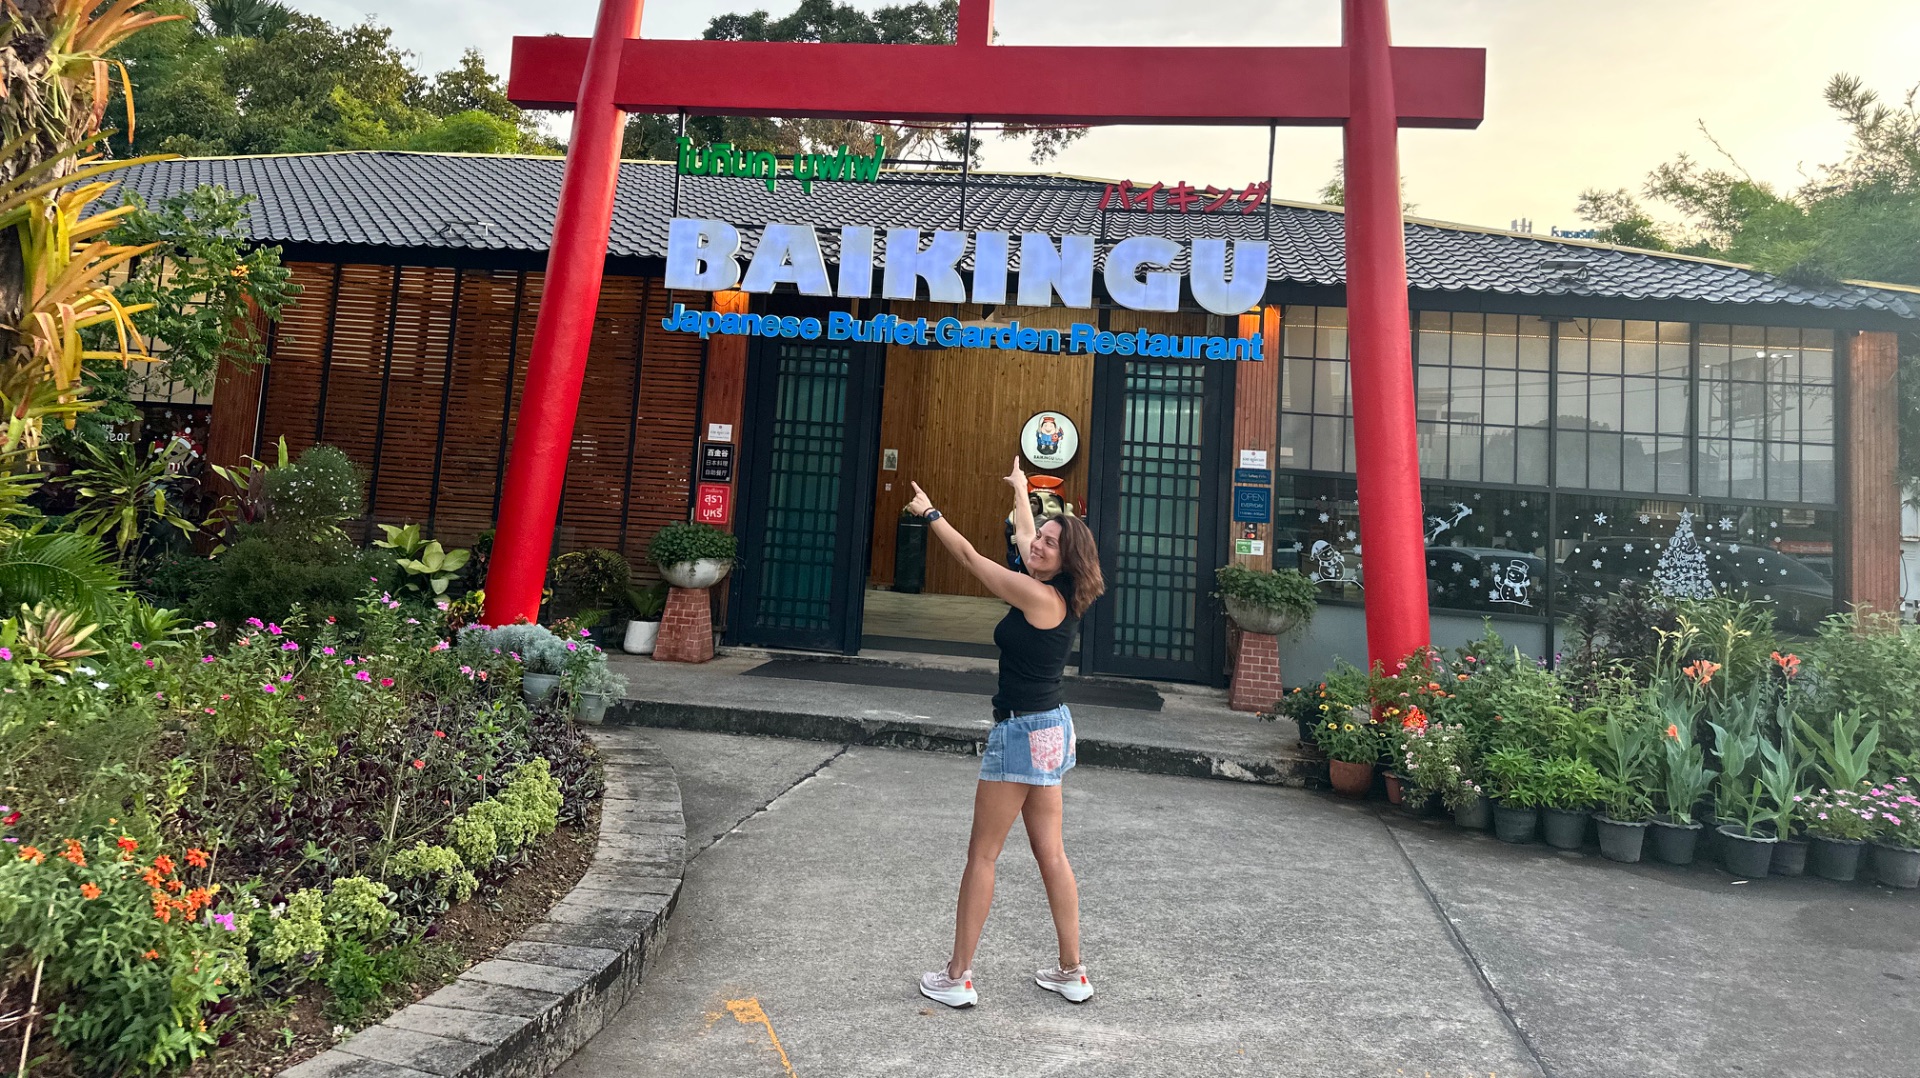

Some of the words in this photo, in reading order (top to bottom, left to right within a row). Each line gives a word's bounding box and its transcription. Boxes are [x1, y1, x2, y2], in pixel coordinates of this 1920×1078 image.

[1099, 179, 1271, 215] バイキング
[665, 218, 1270, 316] BAIKINGU
[662, 303, 822, 339] Japanese
[828, 311, 929, 346] Buffet
[934, 316, 1061, 352] Garden
[1069, 322, 1264, 361] Restaurant
[704, 494, 723, 505] สุรา
[1241, 493, 1264, 502] OPEN
[703, 504, 723, 520] บุหรี่
[1673, 550, 1695, 561] Merry
[1668, 557, 1701, 569] Christmas
